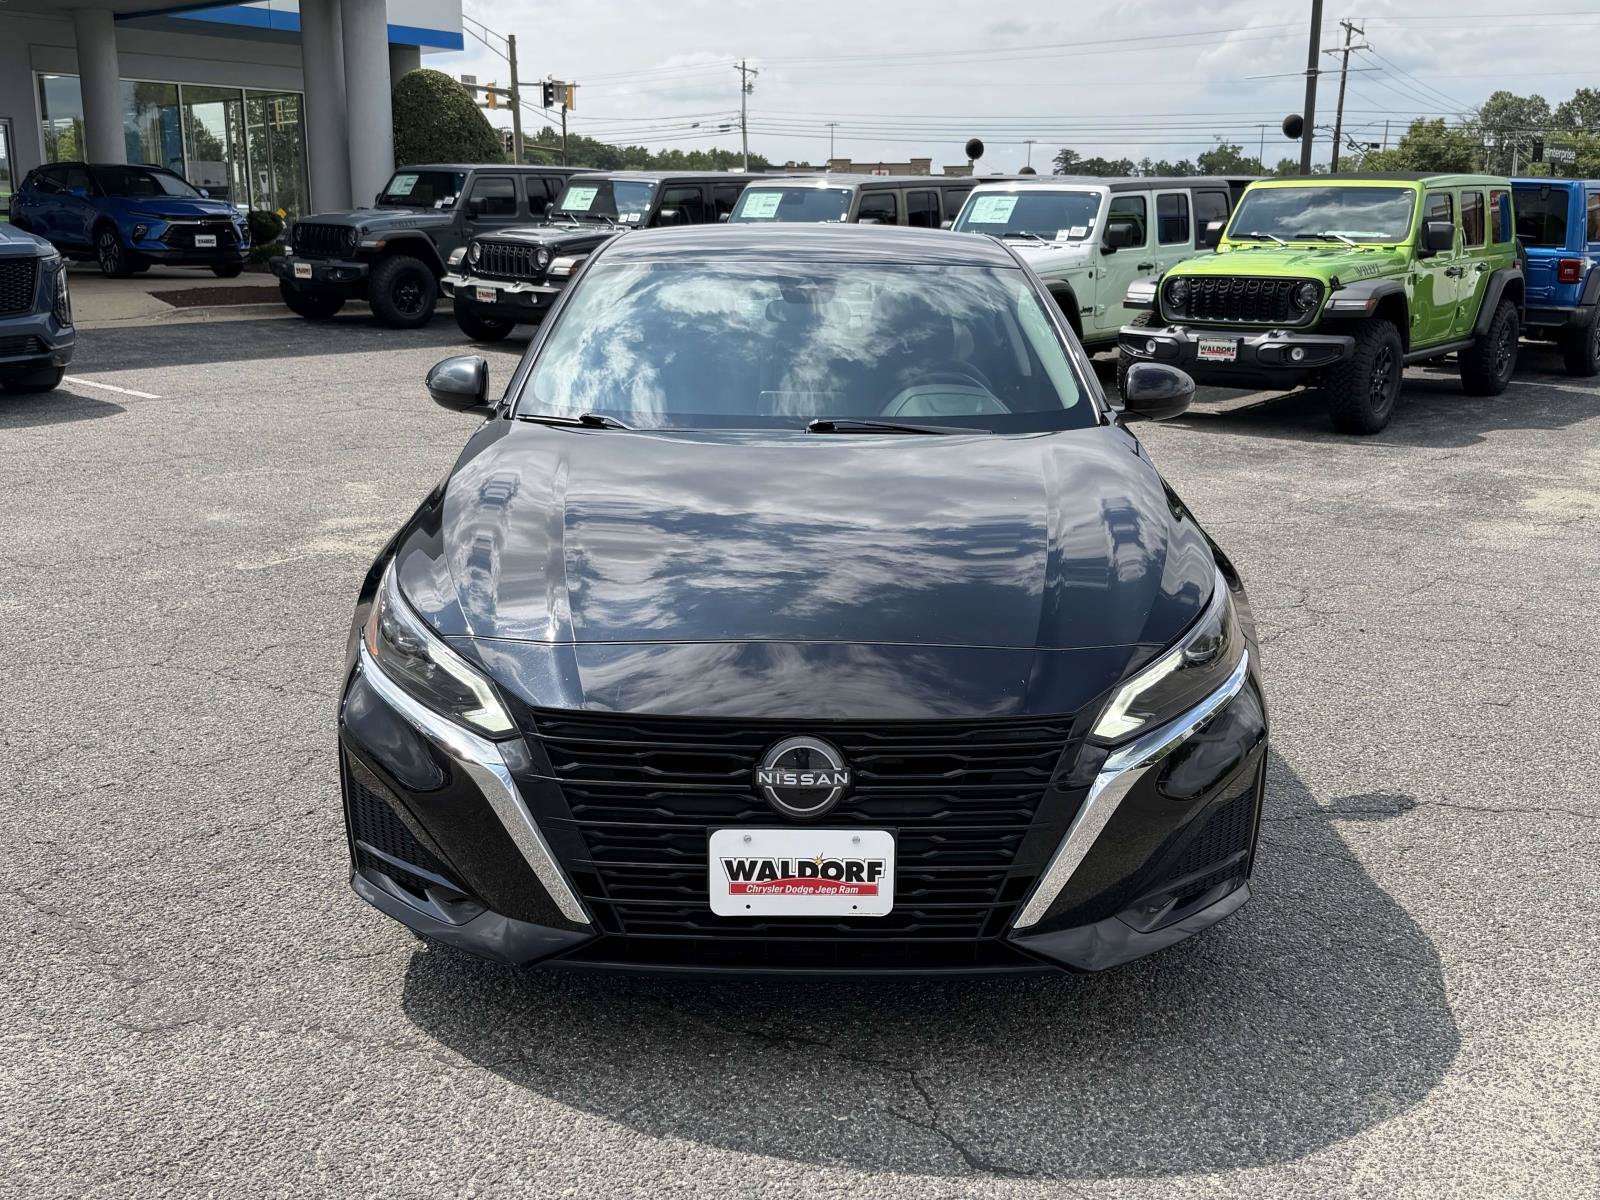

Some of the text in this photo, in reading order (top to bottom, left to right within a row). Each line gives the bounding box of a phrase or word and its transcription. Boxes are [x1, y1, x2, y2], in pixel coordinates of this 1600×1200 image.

[1544, 147, 1576, 161] enterprise
[1200, 344, 1236, 353] WALDORF
[758, 771, 848, 785] NISSAN
[722, 859, 884, 883] WALDORF
[746, 884, 859, 895] Chrysler Dodge Jeep Ram
